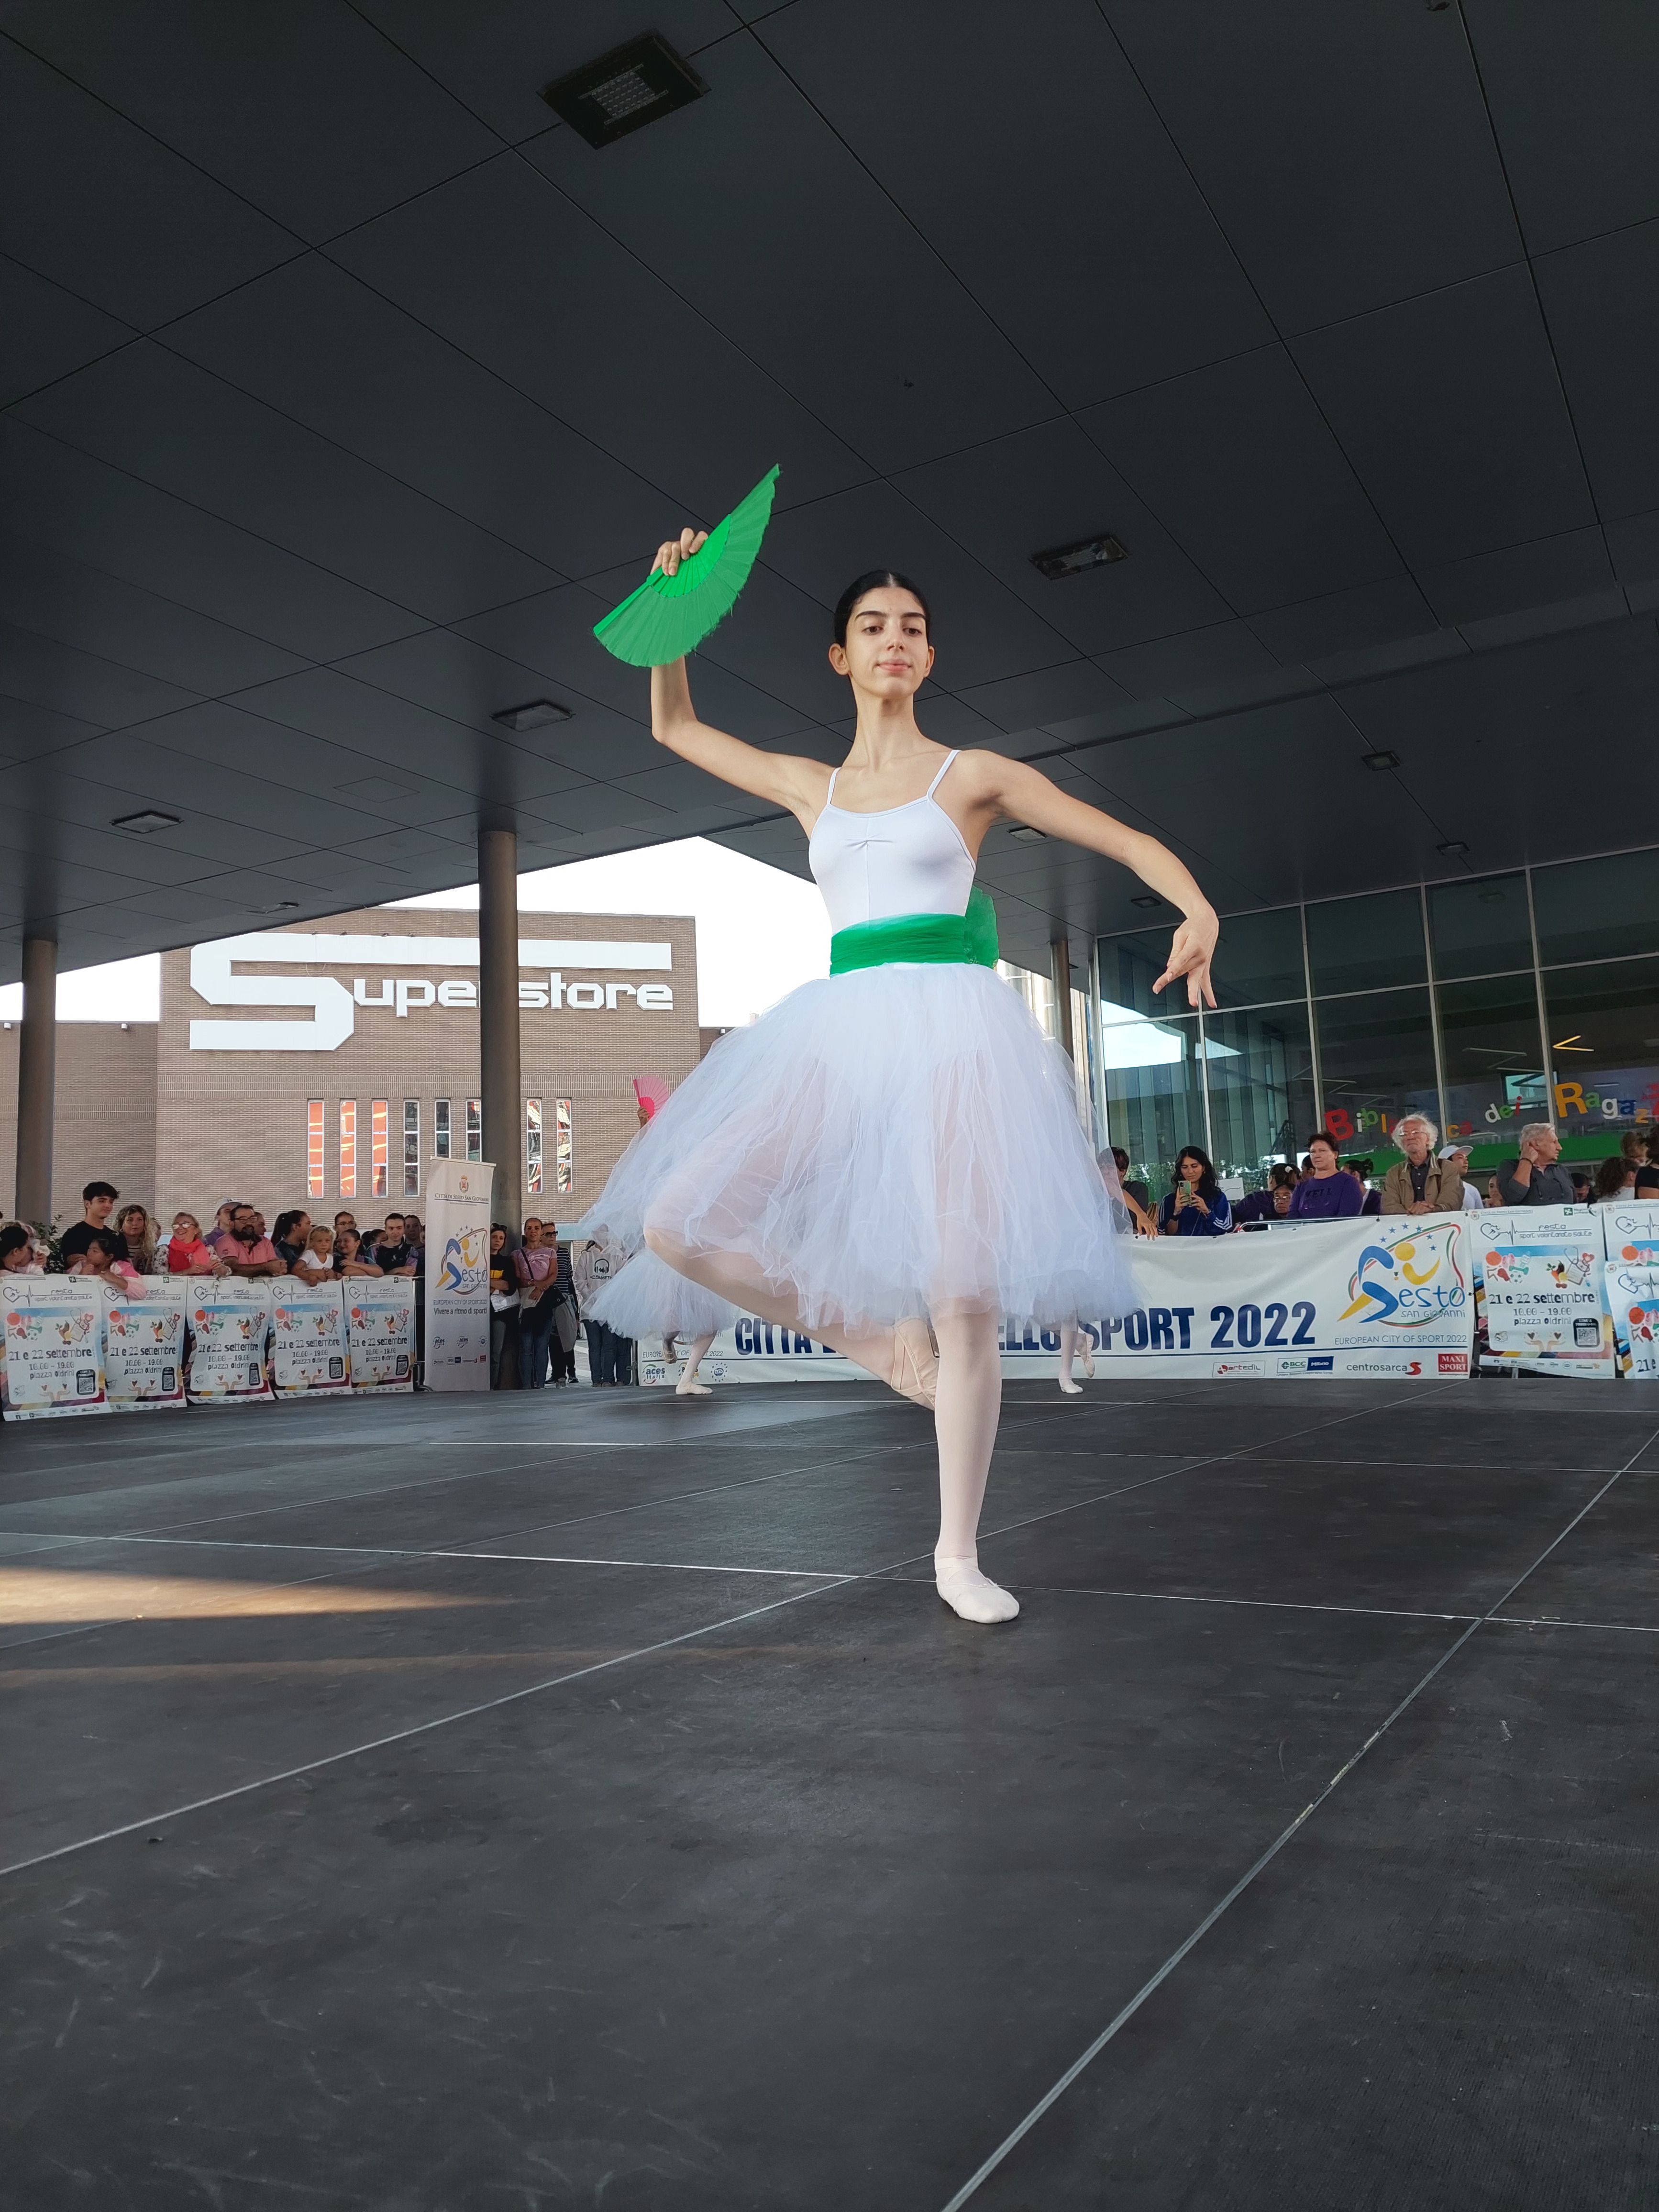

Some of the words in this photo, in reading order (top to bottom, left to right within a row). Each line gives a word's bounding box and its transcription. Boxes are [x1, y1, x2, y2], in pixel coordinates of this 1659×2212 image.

[189, 932, 673, 1051] Supestore
[1485, 1096, 1521, 1123] dei
[1489, 1294, 1503, 1304] 21
[1506, 1295, 1513, 1304] e
[1516, 1294, 1530, 1304] 22
[1534, 1292, 1595, 1304] settembre
[1548, 1307, 1571, 1316] 19.00
[1210, 1301, 1316, 1348] 2022
[277, 1341, 287, 1349] 21
[296, 1340, 304, 1348] 22
[1335, 1336, 1379, 1345] EUROPEAN
[110, 1347, 120, 1356] 21
[128, 1347, 138, 1356] 22
[140, 1346, 176, 1355] settembre
[198, 1344, 205, 1353] 21
[211, 1344, 221, 1352] 22
[9, 1351, 20, 1361] 21
[32, 1350, 44, 1359] 22
[46, 1348, 92, 1359] settembre
[1347, 1363, 1407, 1371] centrosarca
[1636, 1359, 1650, 1372] 21
[1651, 1359, 1656, 1369] e
